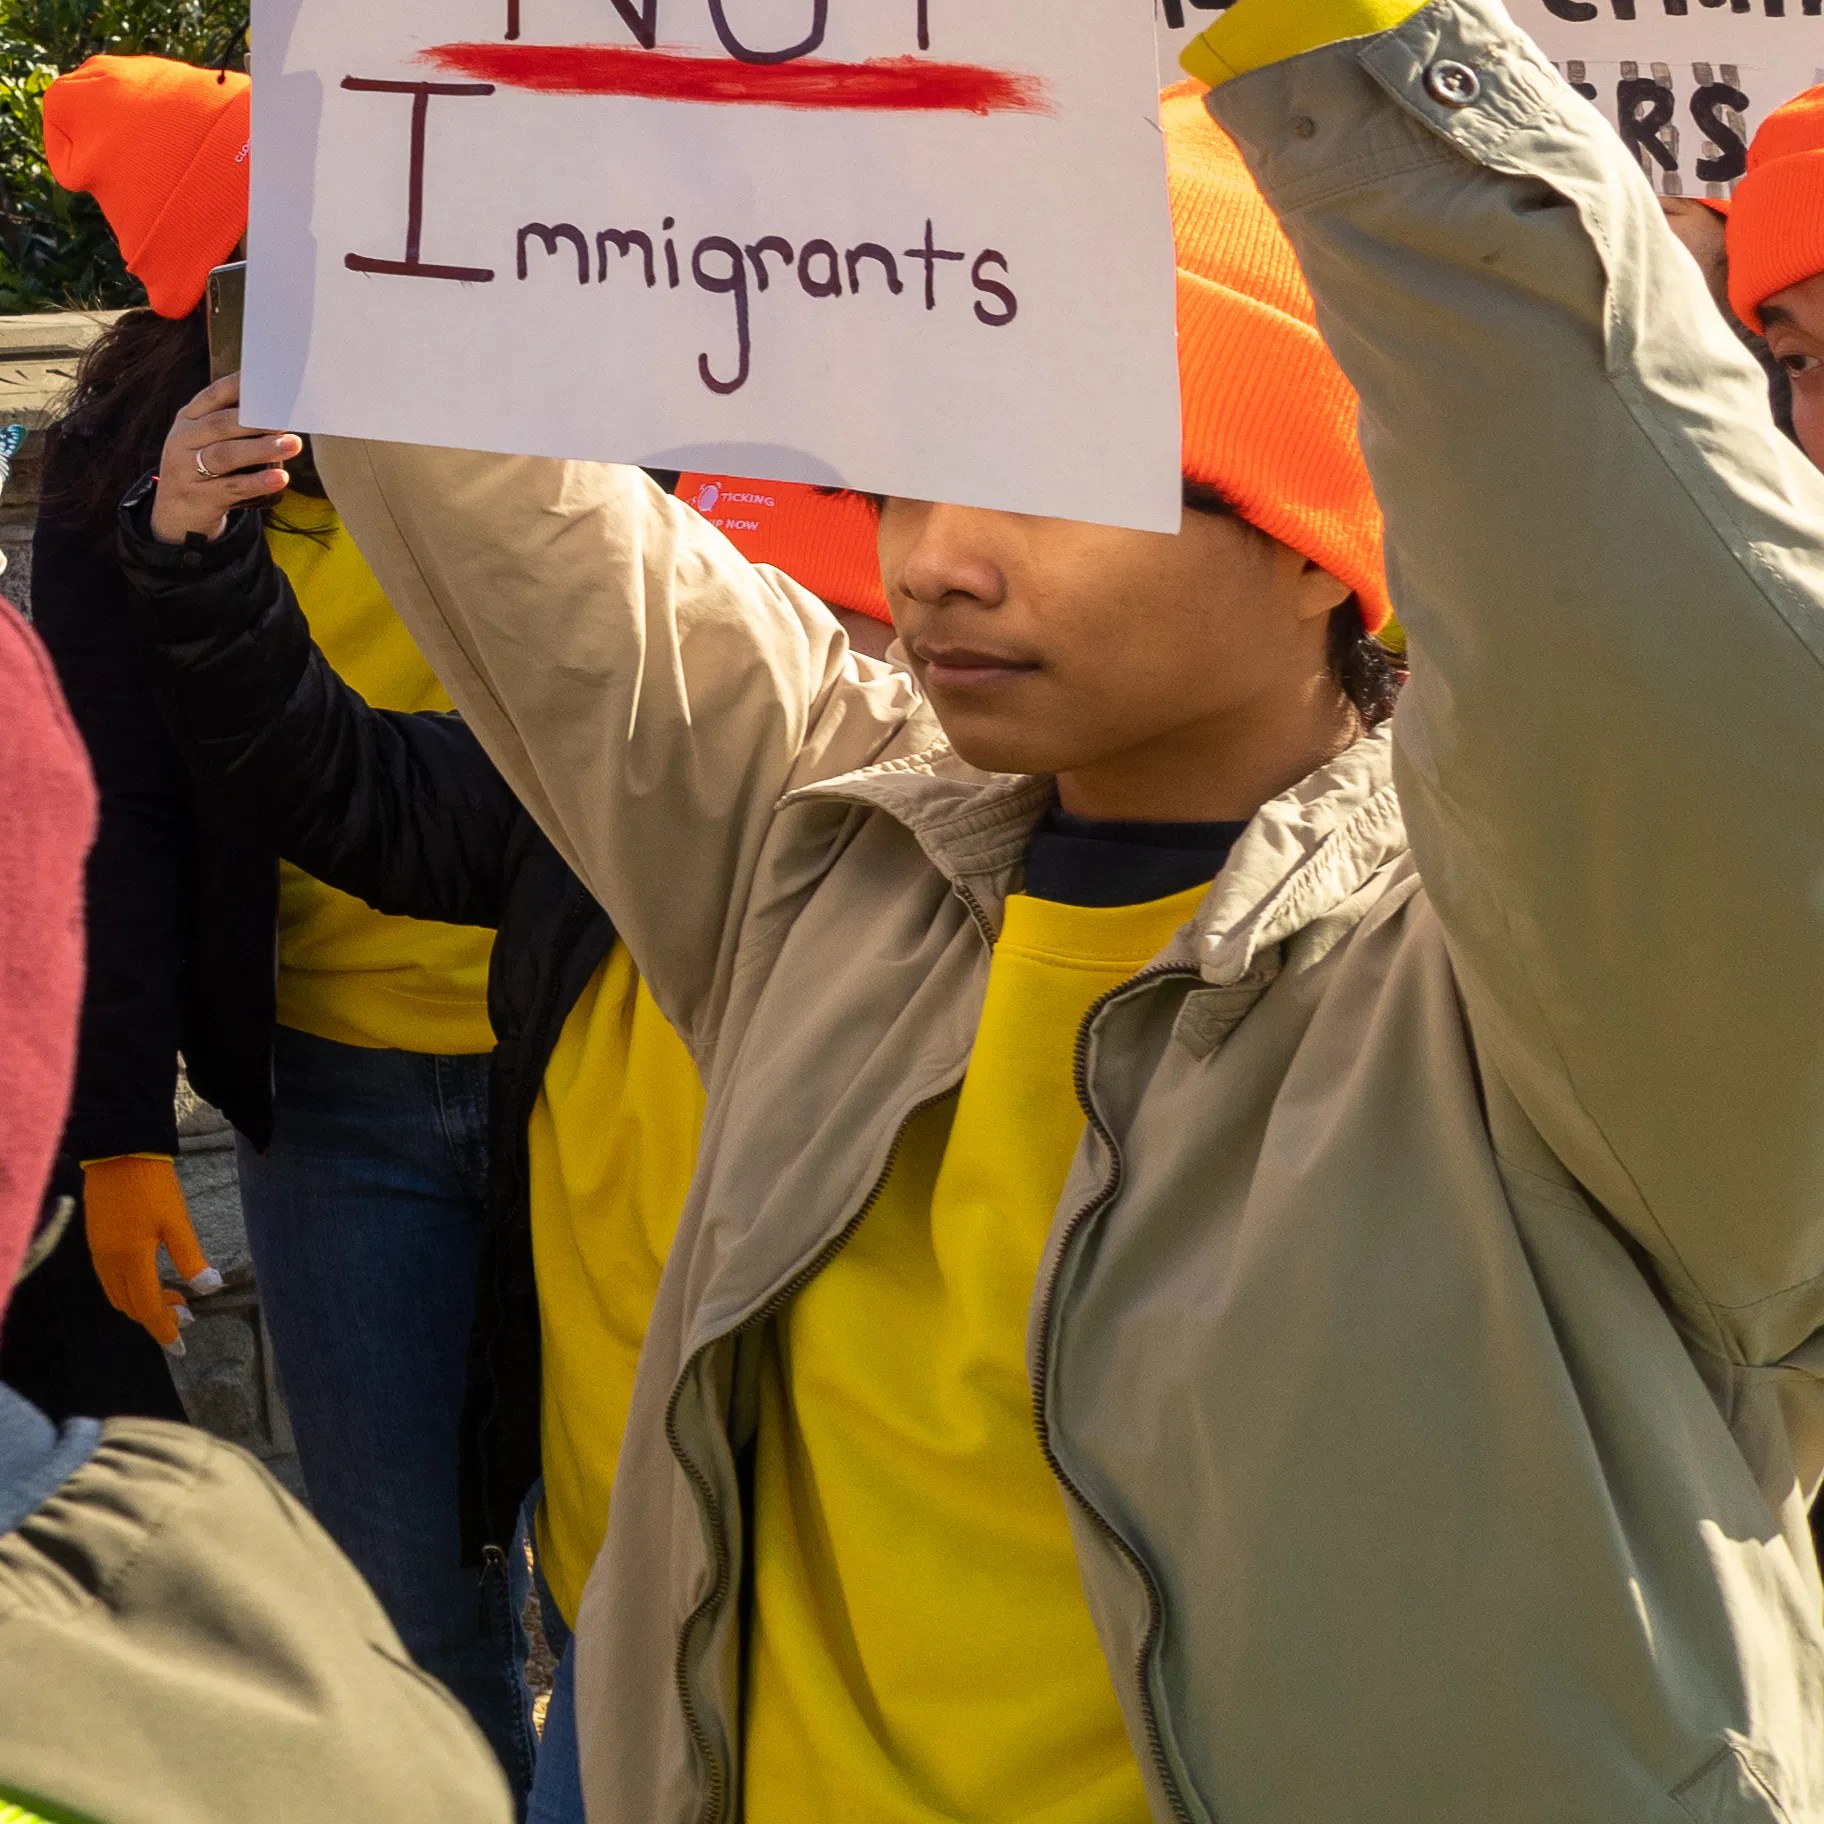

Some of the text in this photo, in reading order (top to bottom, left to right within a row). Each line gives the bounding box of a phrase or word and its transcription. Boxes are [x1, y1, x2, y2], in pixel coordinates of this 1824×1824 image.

[1569, 77, 1750, 183] RS
[339, 75, 1018, 395] Immigrants
[721, 493, 775, 507] TICKING
[727, 518, 759, 531] NOW
